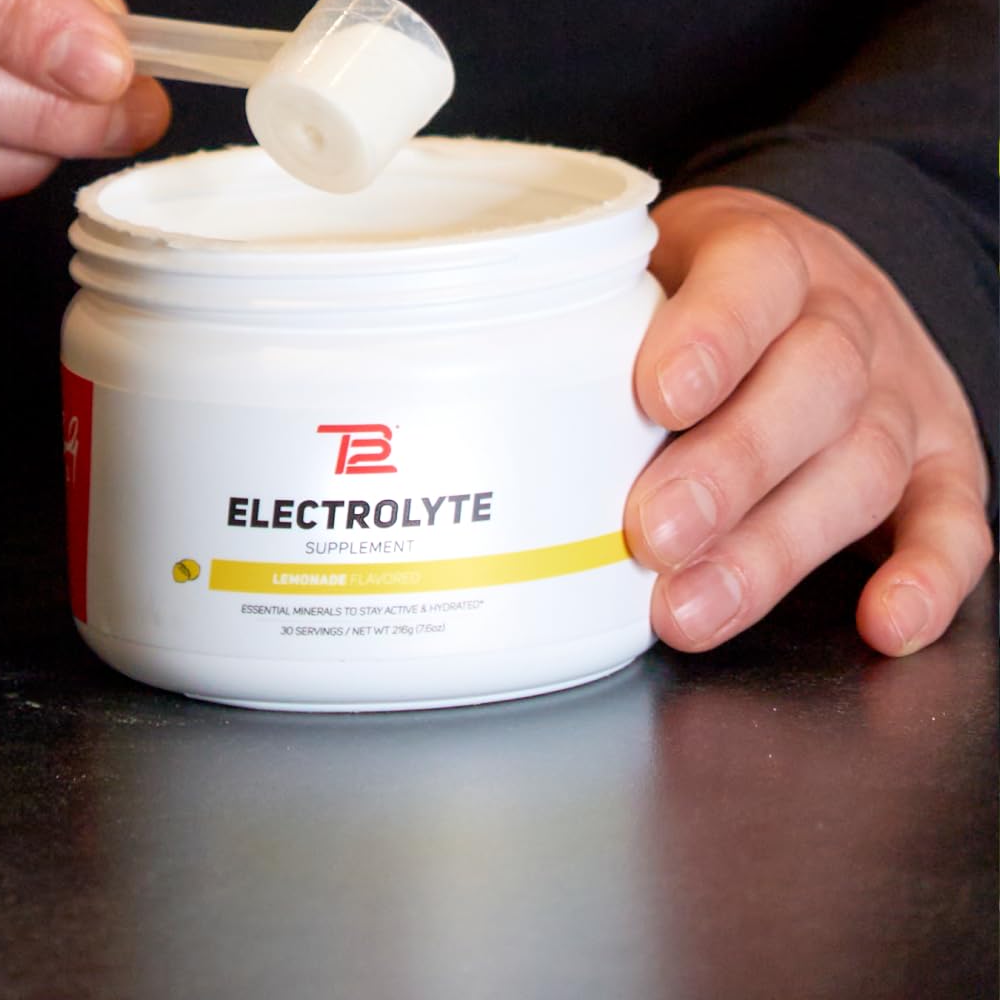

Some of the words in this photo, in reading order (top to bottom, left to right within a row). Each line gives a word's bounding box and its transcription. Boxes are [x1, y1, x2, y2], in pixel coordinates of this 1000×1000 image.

[227, 491, 494, 530] ELECTROLYTE
[305, 539, 415, 554] SUPPLEMENT
[272, 572, 347, 585] LEMONADE
[349, 571, 422, 585] FLAVORED
[241, 604, 291, 616] ESSENTIAL
[293, 606, 342, 617] MINERALS
[344, 606, 357, 616] TO
[359, 605, 383, 616] STAY
[384, 604, 418, 616] ACTIVE
[420, 603, 427, 614] &
[280, 625, 294, 636] 30
[295, 626, 344, 637] SERVINGS
[344, 626, 351, 637] /
[352, 626, 372, 636] NET
[373, 625, 390, 636] WT
